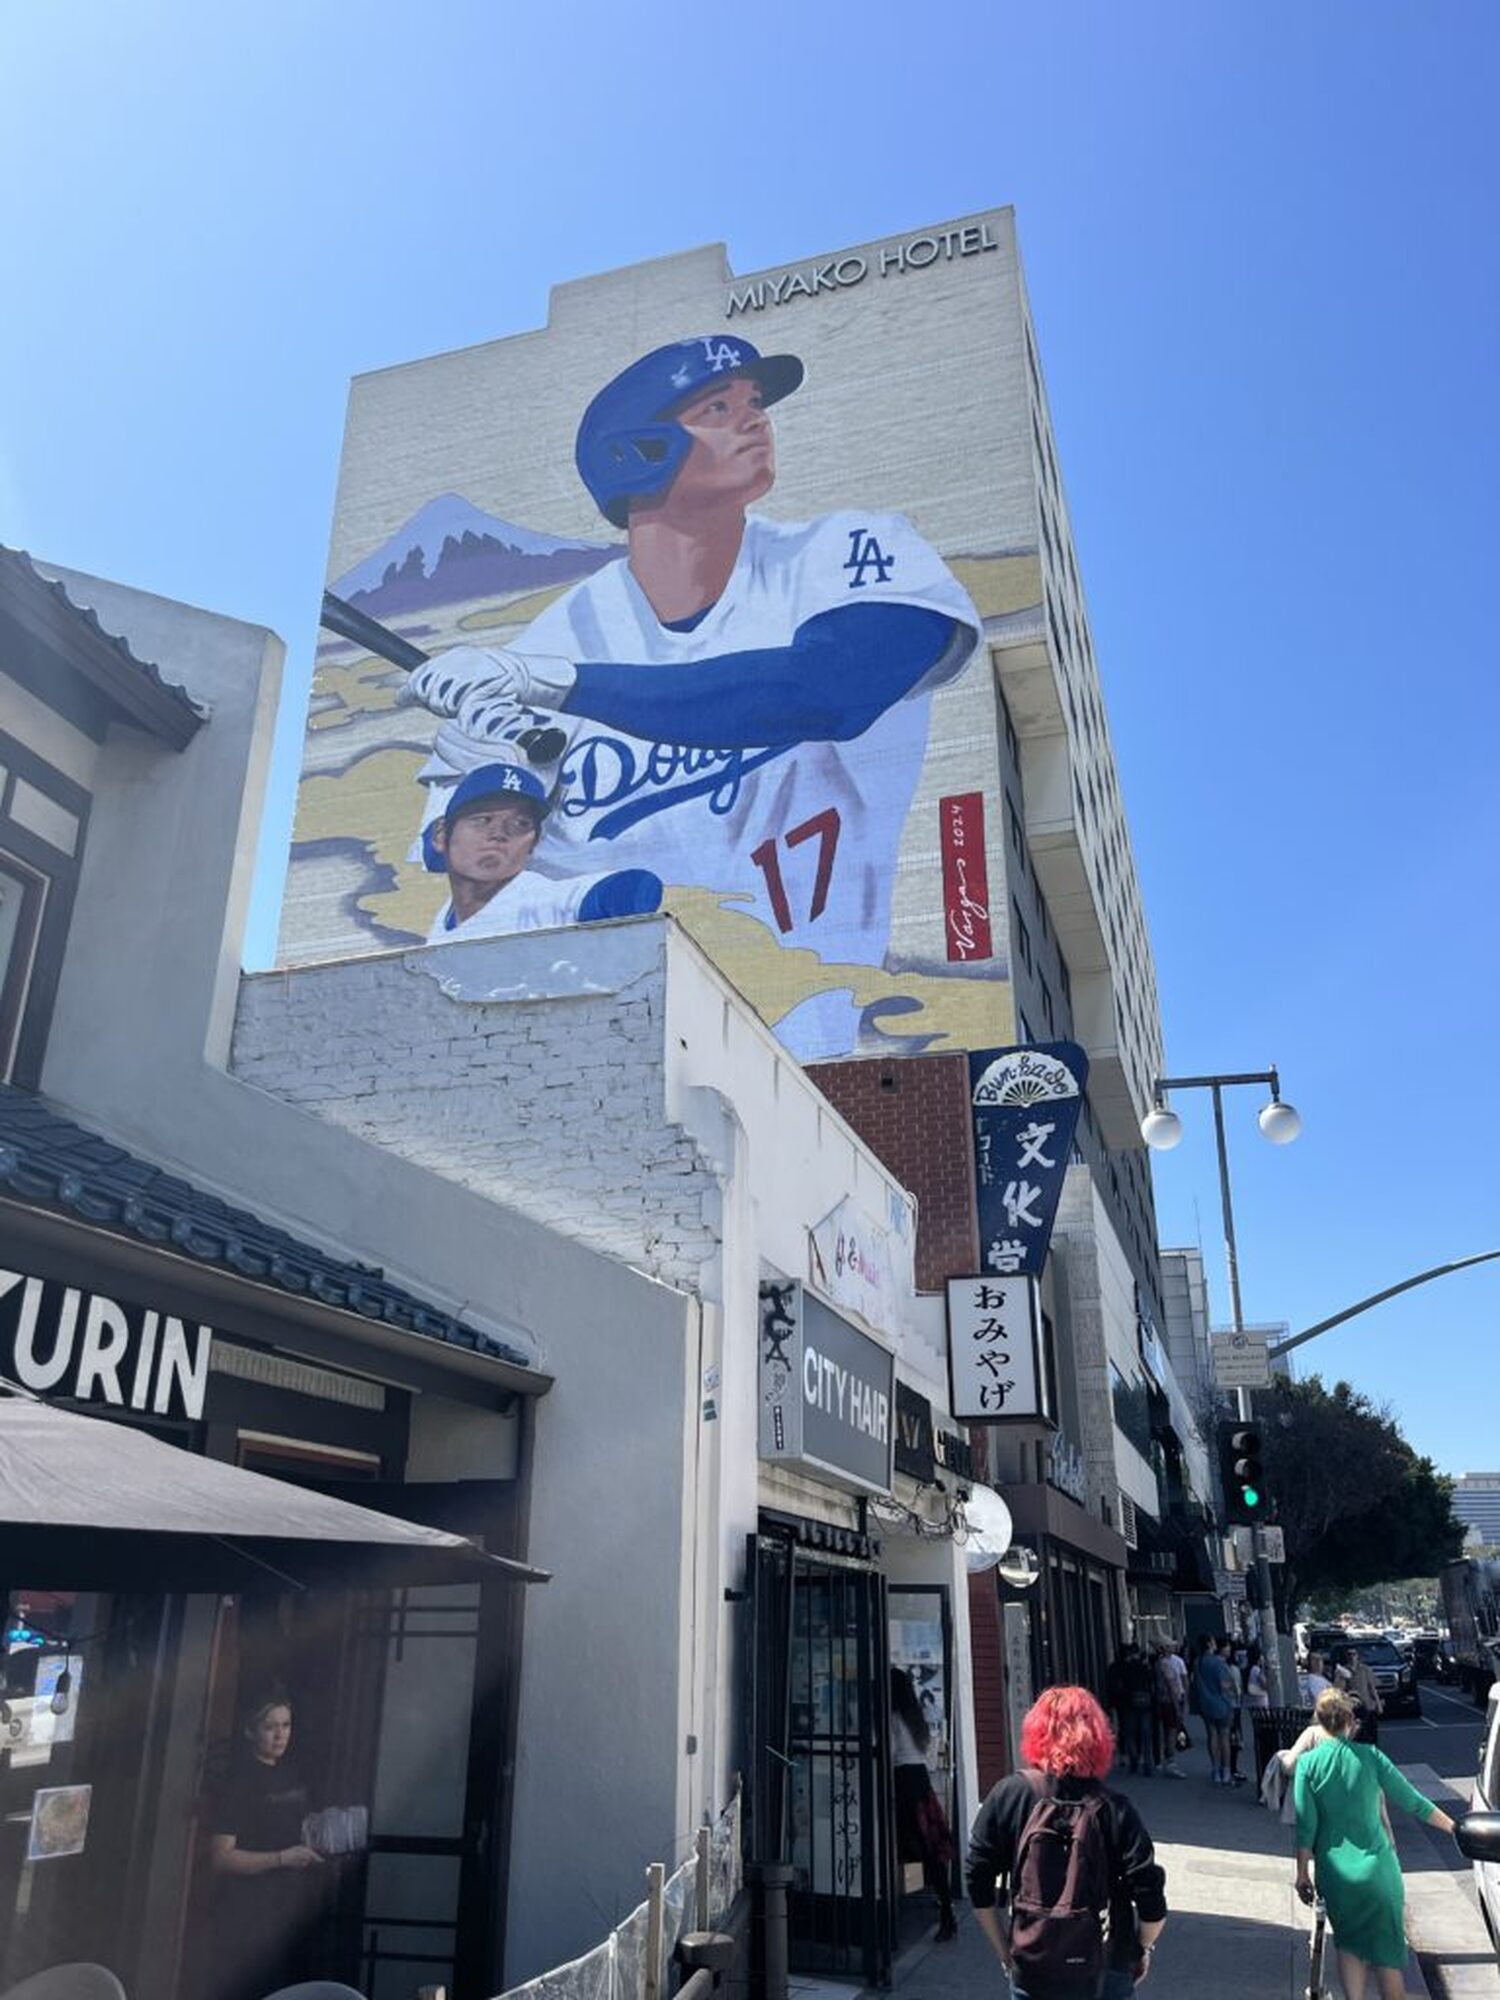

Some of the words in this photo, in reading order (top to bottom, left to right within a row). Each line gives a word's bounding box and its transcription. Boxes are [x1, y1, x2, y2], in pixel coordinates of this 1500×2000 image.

[726, 256, 867, 318] MIYAKO
[879, 224, 998, 277] HOTEL
[700, 338, 741, 371] LA
[843, 528, 894, 589] LA
[502, 768, 521, 791] LA
[951, 805, 965, 847] 2024
[751, 807, 841, 934] 17
[0, 1269, 212, 1420] URIN
[973, 1285, 1016, 1410] おみやげ
[803, 1346, 848, 1420] CITY
[851, 1375, 889, 1445] HAIR
